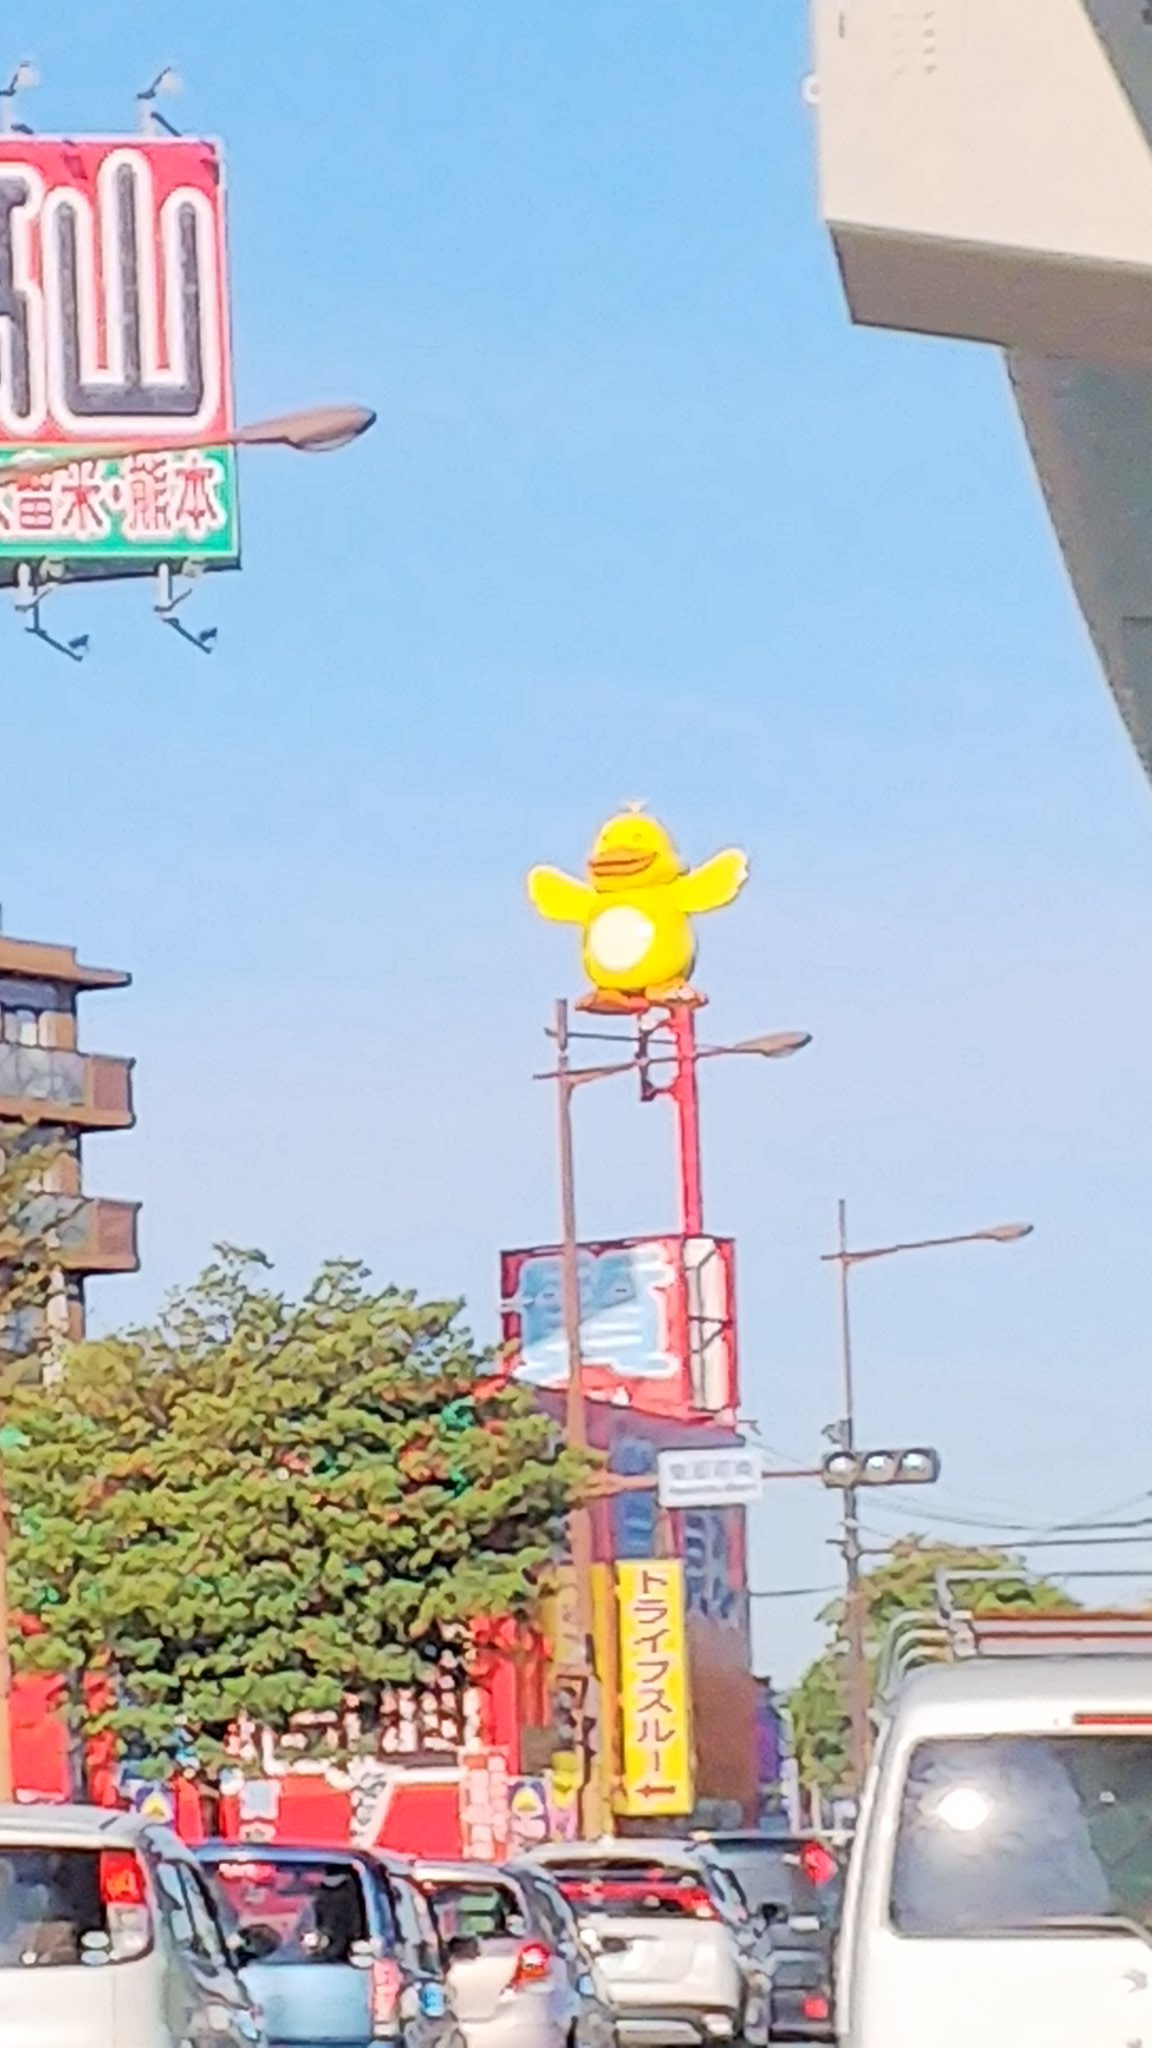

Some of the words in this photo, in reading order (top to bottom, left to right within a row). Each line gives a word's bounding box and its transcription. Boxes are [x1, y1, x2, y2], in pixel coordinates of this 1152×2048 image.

[0, 158, 206, 418] 山
[0, 452, 220, 530] 留米・熊本
